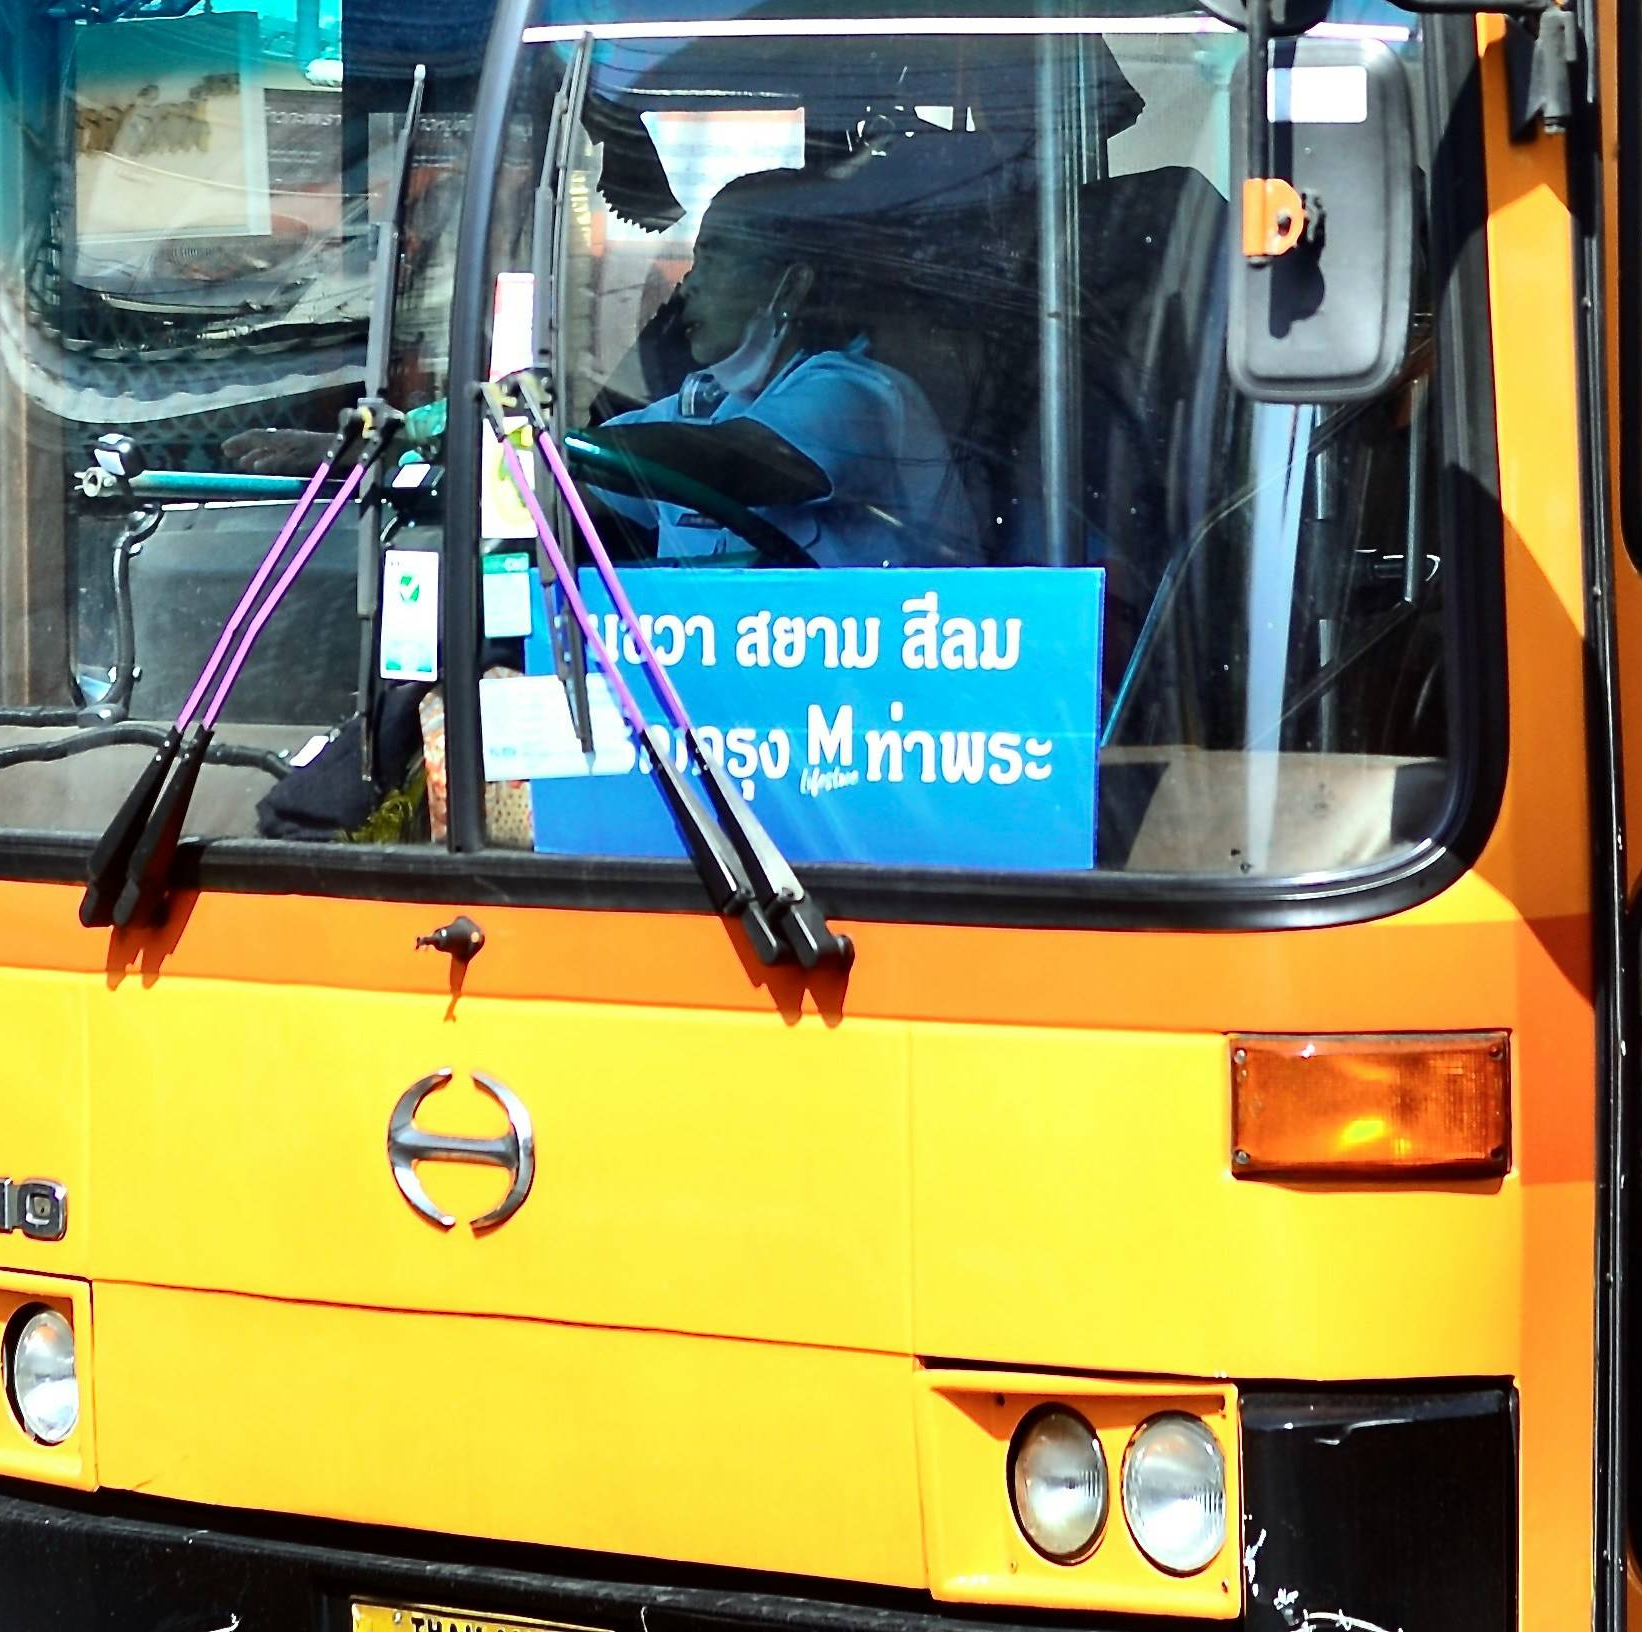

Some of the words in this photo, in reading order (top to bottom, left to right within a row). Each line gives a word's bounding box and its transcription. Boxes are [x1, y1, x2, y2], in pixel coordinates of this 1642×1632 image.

[736, 610, 879, 668] สยาม
[901, 591, 1021, 671] สีลม
[807, 704, 853, 766] M
[865, 701, 1053, 784] ท่าพระ
